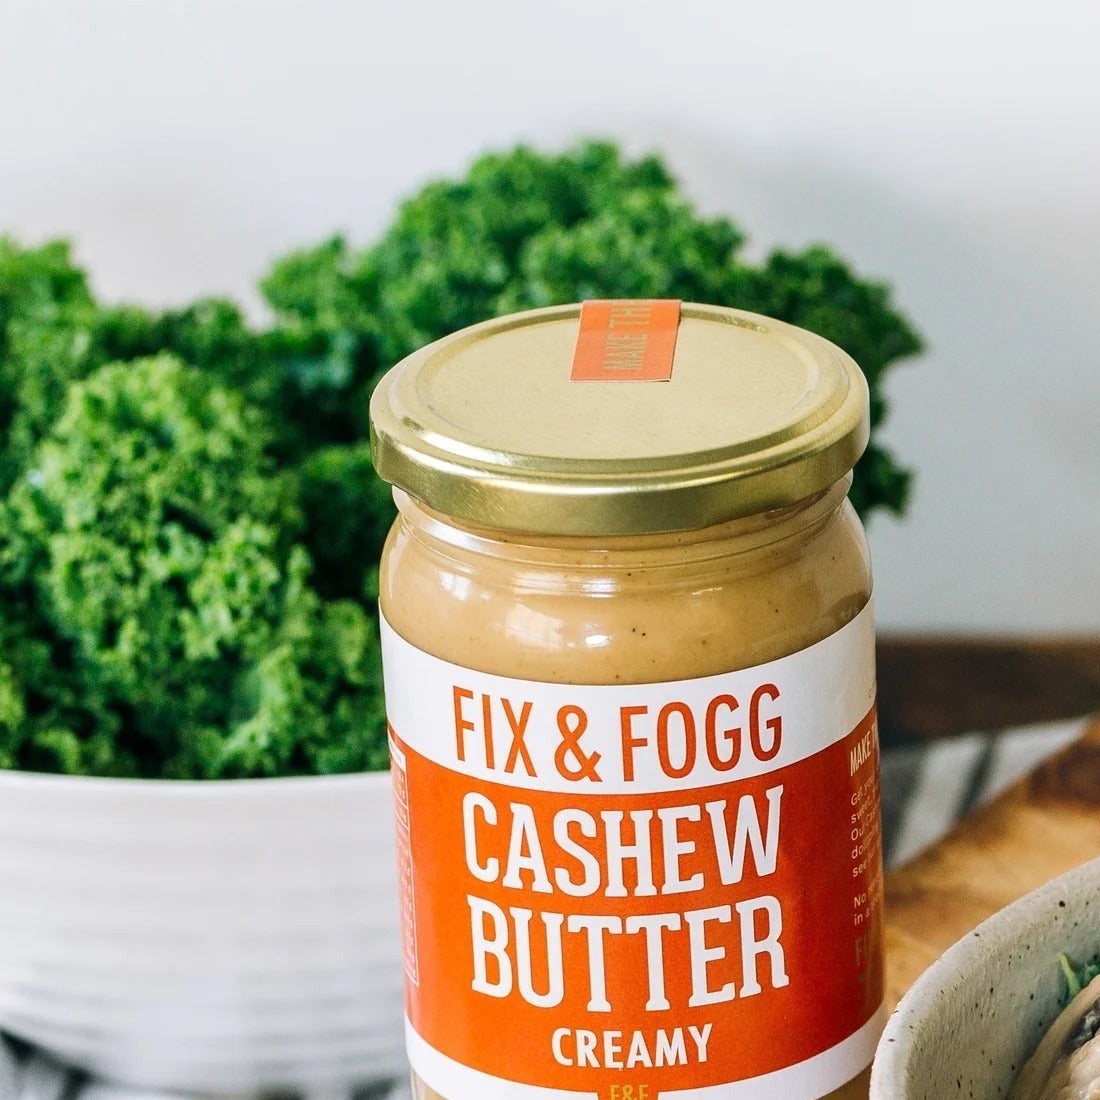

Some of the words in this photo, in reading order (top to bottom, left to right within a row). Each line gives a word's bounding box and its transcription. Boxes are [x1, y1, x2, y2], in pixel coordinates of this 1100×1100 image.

[601, 332, 648, 370] MAKE
[453, 685, 537, 778] FIX
[554, 705, 602, 782] &
[620, 683, 783, 782] FOGG
[850, 729, 871, 777] MAKE
[462, 784, 784, 898] CASHEW
[854, 913, 864, 927] in
[466, 894, 790, 1013] BUTTER
[551, 1023, 713, 1069] CREAMY
